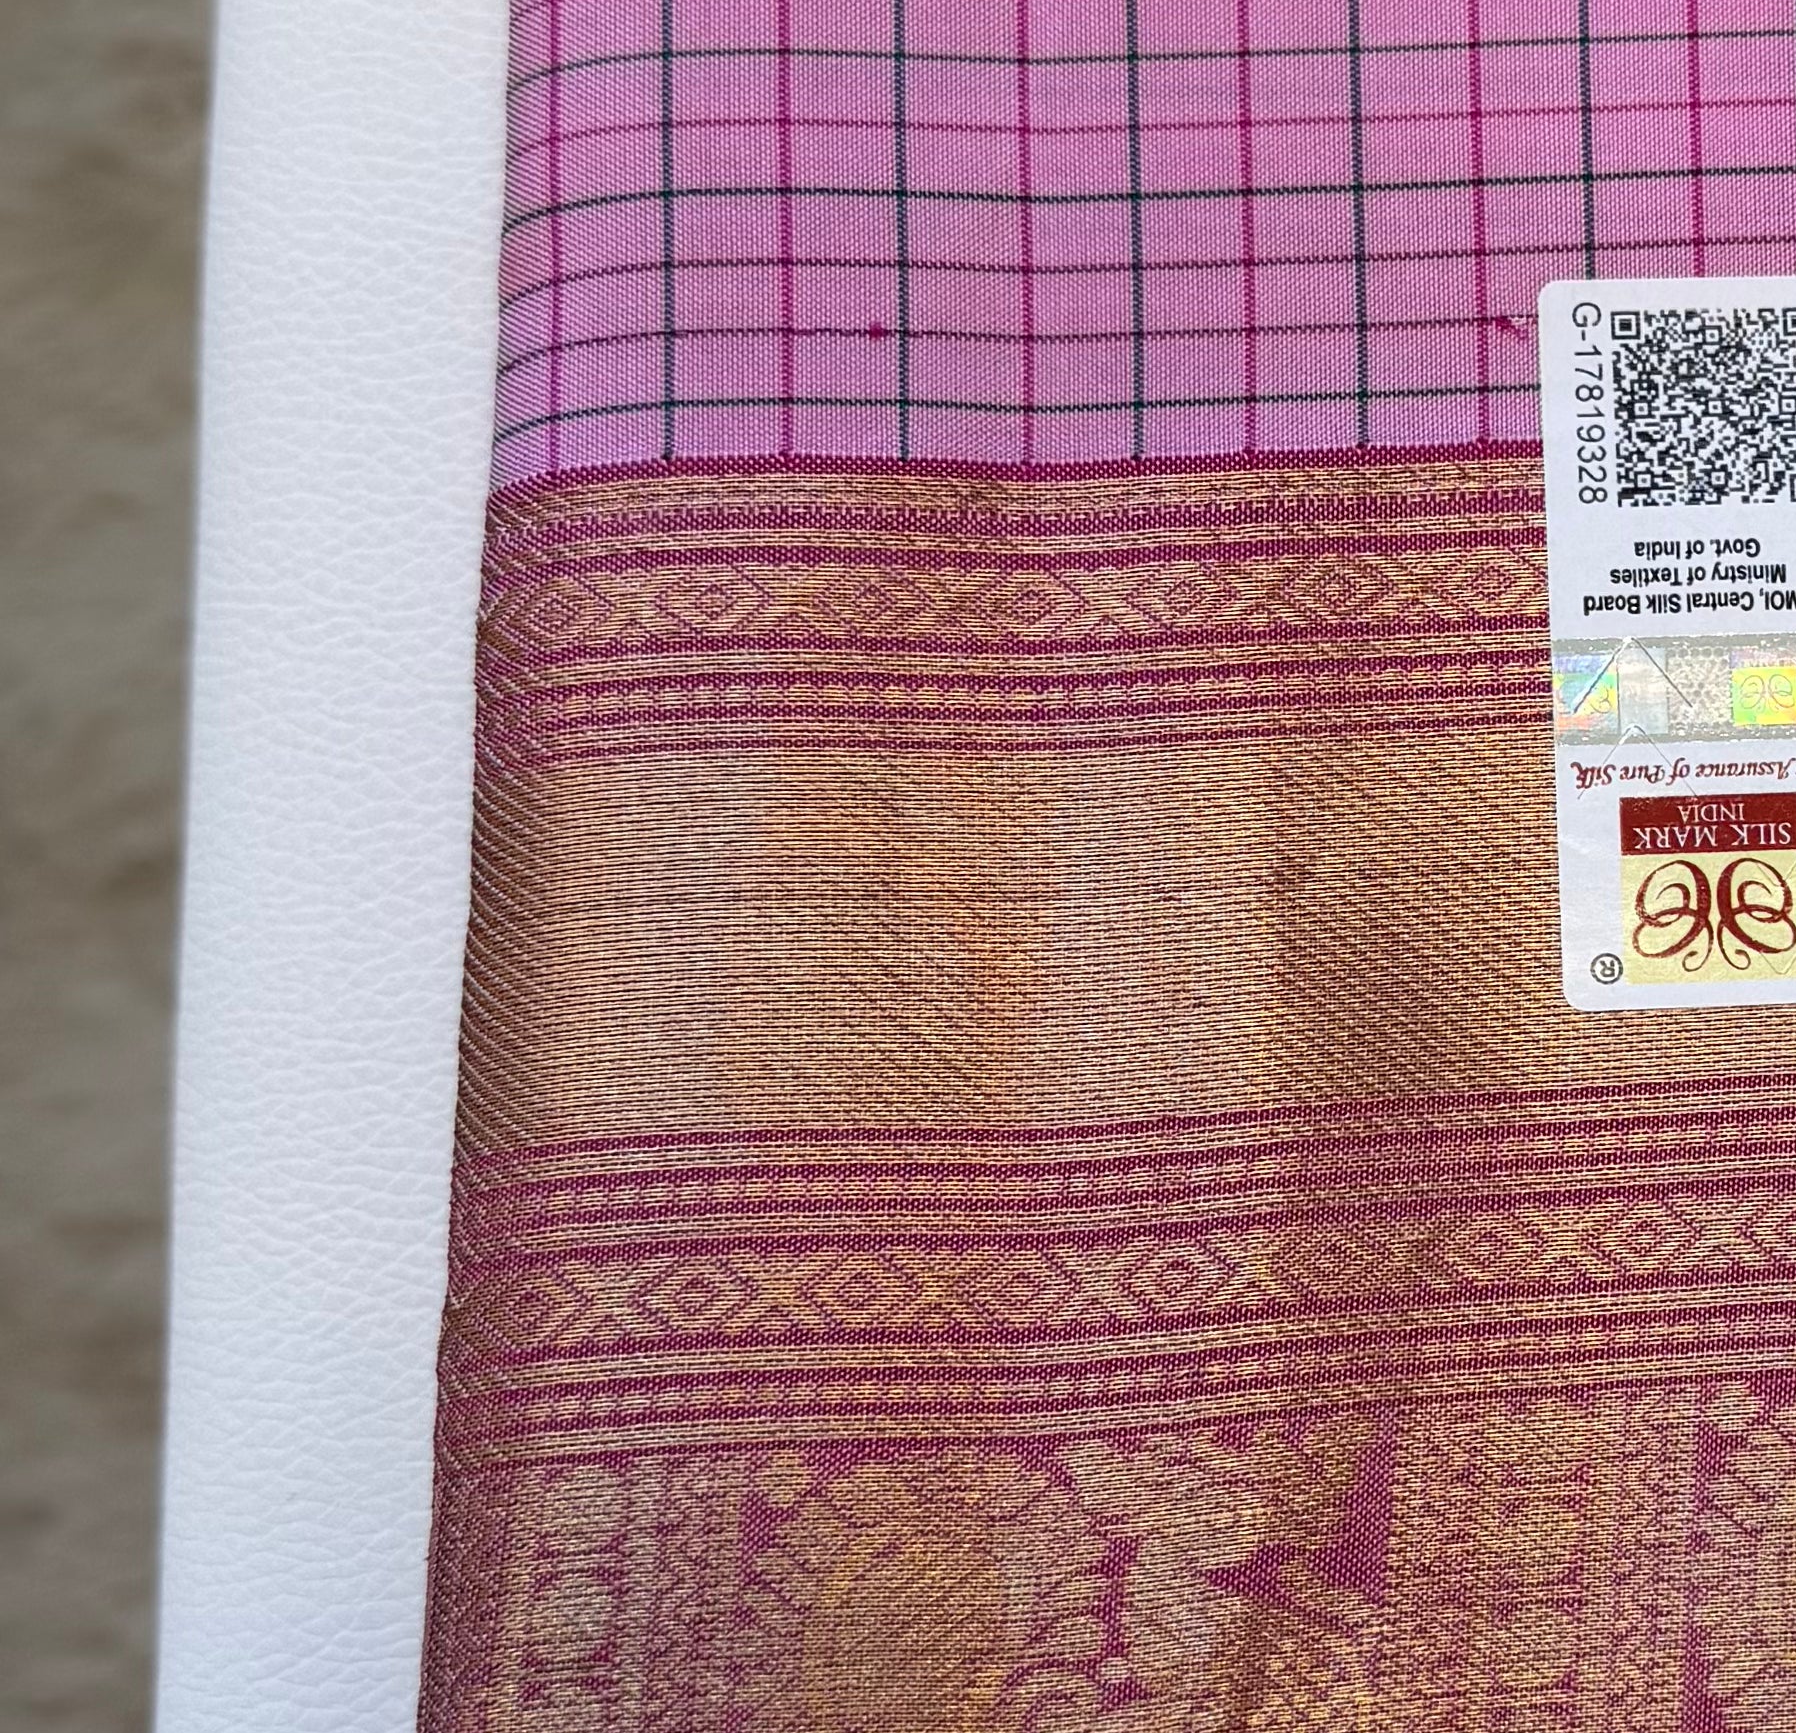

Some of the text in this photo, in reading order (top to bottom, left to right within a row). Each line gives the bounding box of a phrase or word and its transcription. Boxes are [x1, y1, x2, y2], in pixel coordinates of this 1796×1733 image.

[1572, 302, 1608, 504] G-17819328
[1634, 537, 1761, 560] Govt. of India
[1610, 563, 1787, 588] Ministry of Textiles
[1583, 595, 1641, 616] Board
[1646, 594, 1681, 614] Silk
[1687, 591, 1754, 613] Central
[1570, 761, 1617, 790] Silk
[1620, 764, 1666, 784] Pure
[1666, 757, 1692, 786] of
[1696, 757, 1796, 780] Assurance
[1677, 802, 1745, 824] INDIA
[1633, 821, 1792, 850] SILK MARK
